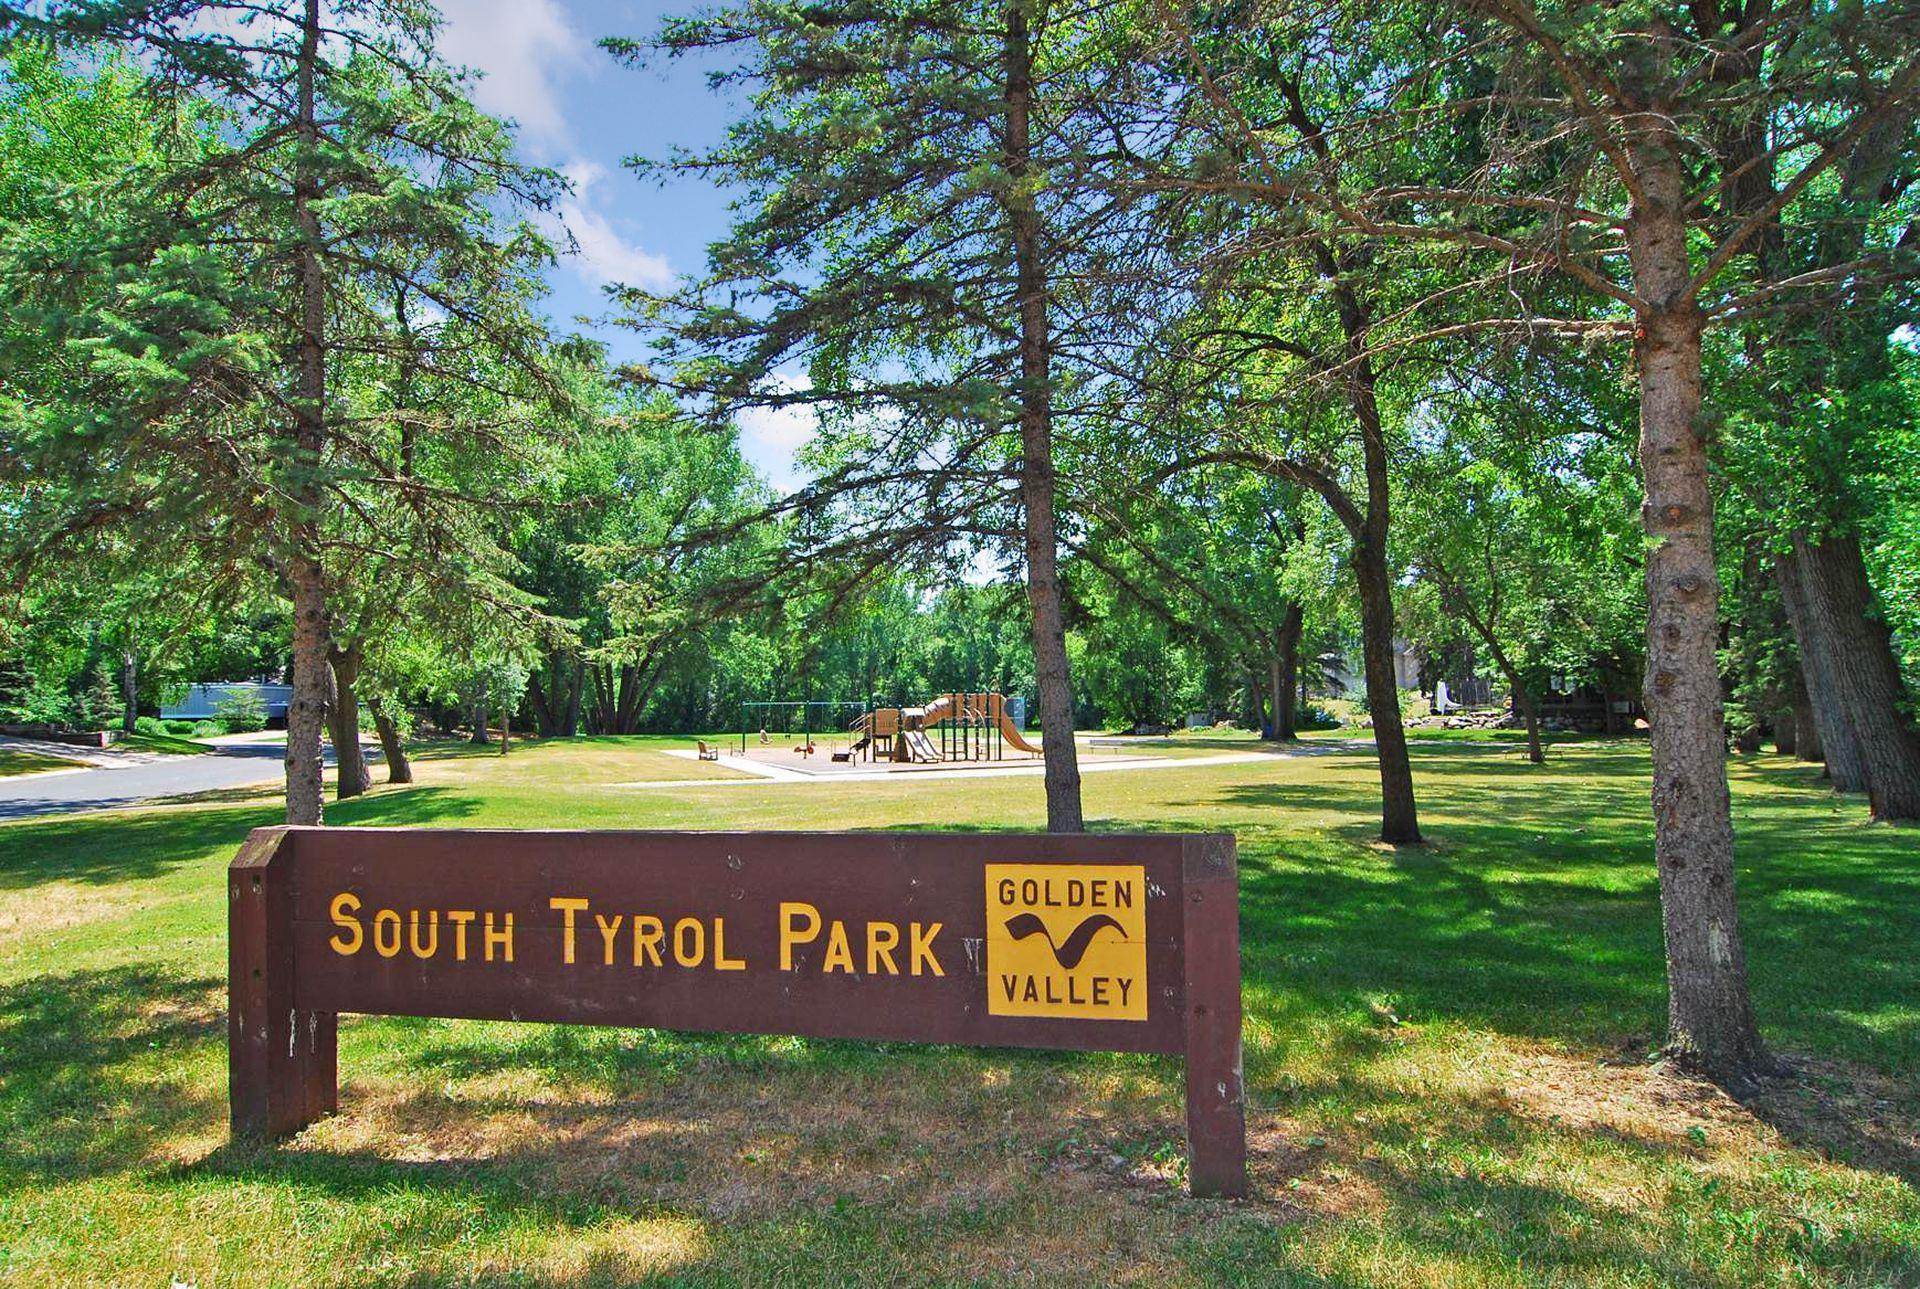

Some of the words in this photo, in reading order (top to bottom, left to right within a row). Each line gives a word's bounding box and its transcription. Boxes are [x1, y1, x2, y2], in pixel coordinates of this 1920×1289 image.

[998, 878, 1132, 909] GOLDEN
[329, 892, 516, 964] SOUTH
[548, 897, 747, 972] TYROL
[779, 901, 946, 977] PARK
[1001, 974, 1133, 1007] VALLEY
